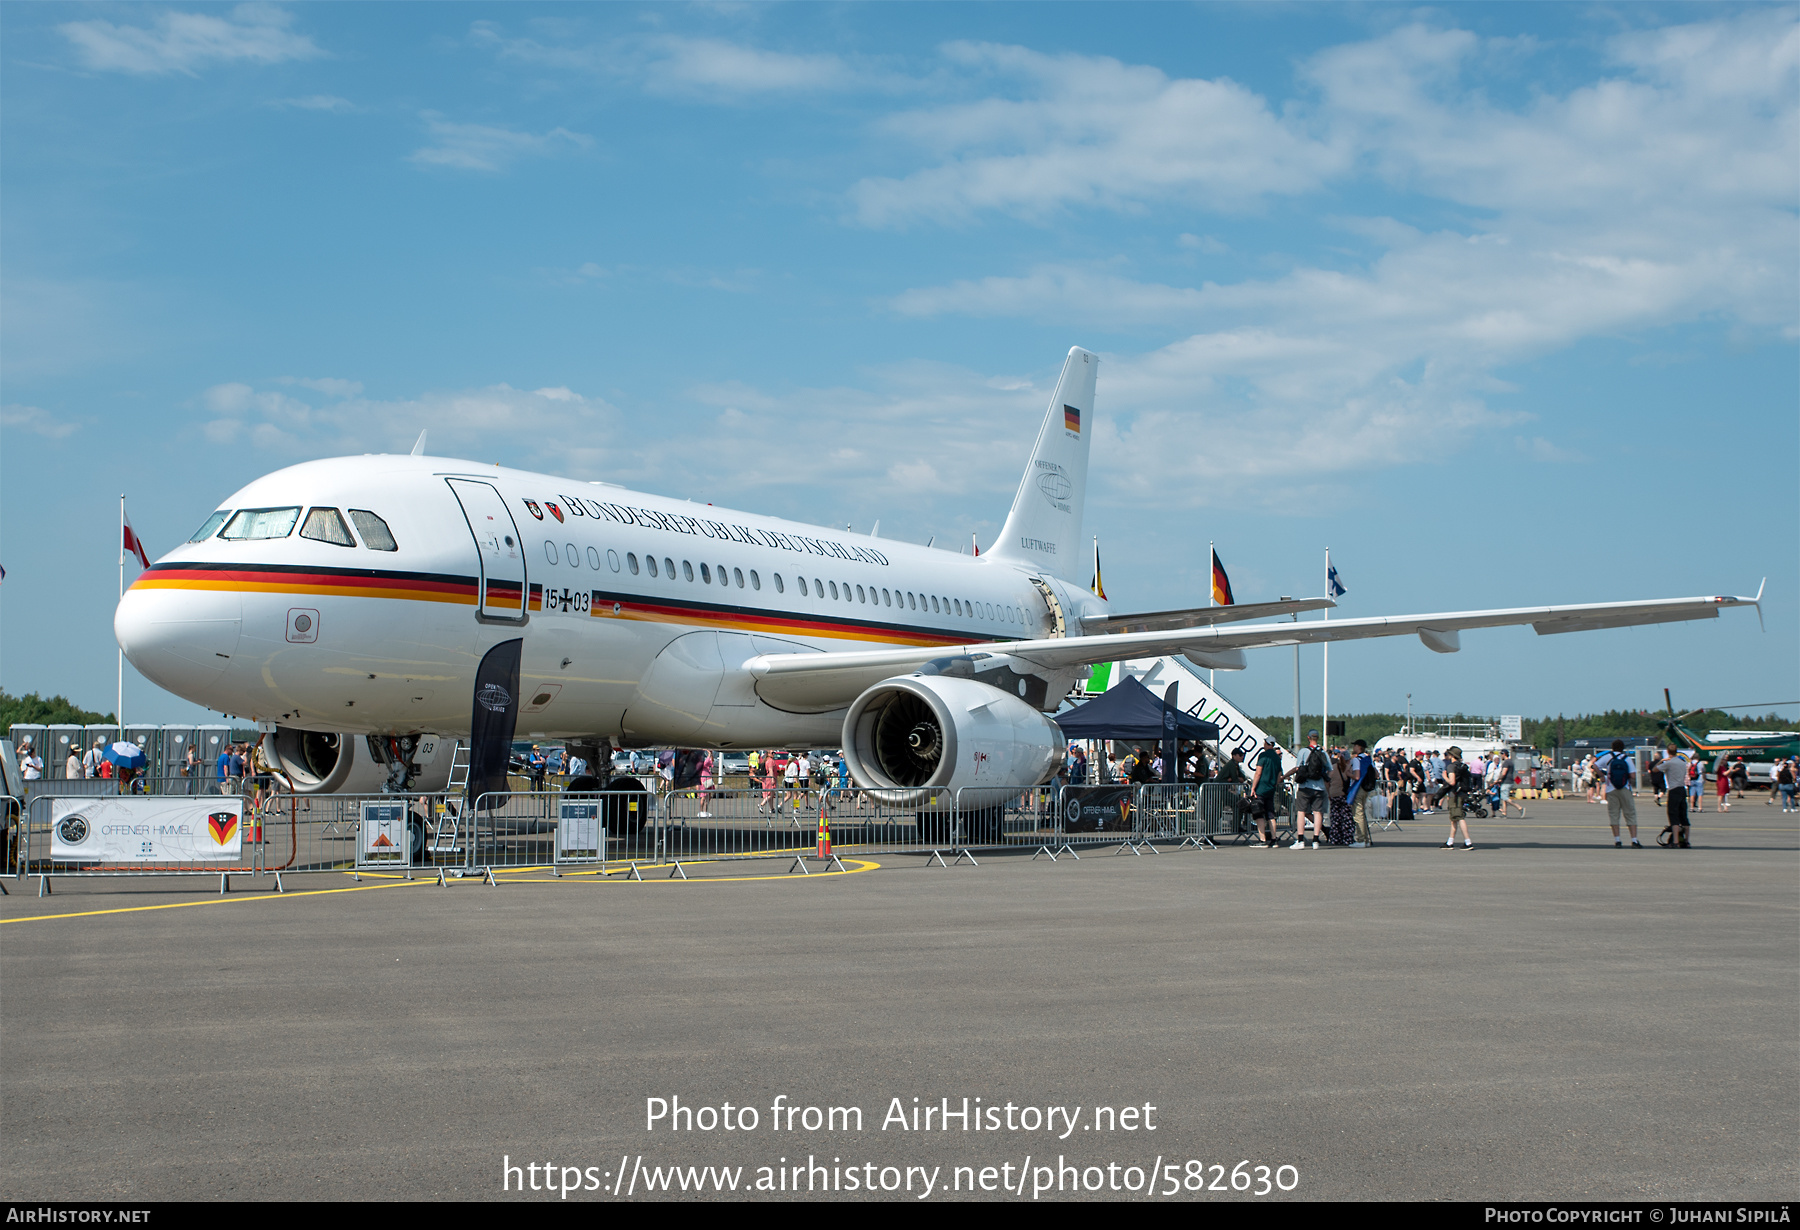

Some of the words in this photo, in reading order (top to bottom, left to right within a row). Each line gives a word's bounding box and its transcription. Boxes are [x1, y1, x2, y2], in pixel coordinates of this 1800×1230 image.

[1034, 460, 1058, 472] OFFENER
[559, 494, 763, 546] BUNDESREPUBLIK
[756, 528, 889, 566] DEUTSCHLAND
[1020, 537, 1057, 555] LUFTWAFFE
[545, 588, 559, 609] 15
[573, 591, 590, 612] 03
[422, 742, 434, 754] 03
[101, 824, 150, 836] OFFENER
[153, 824, 193, 836] HIMMEL
